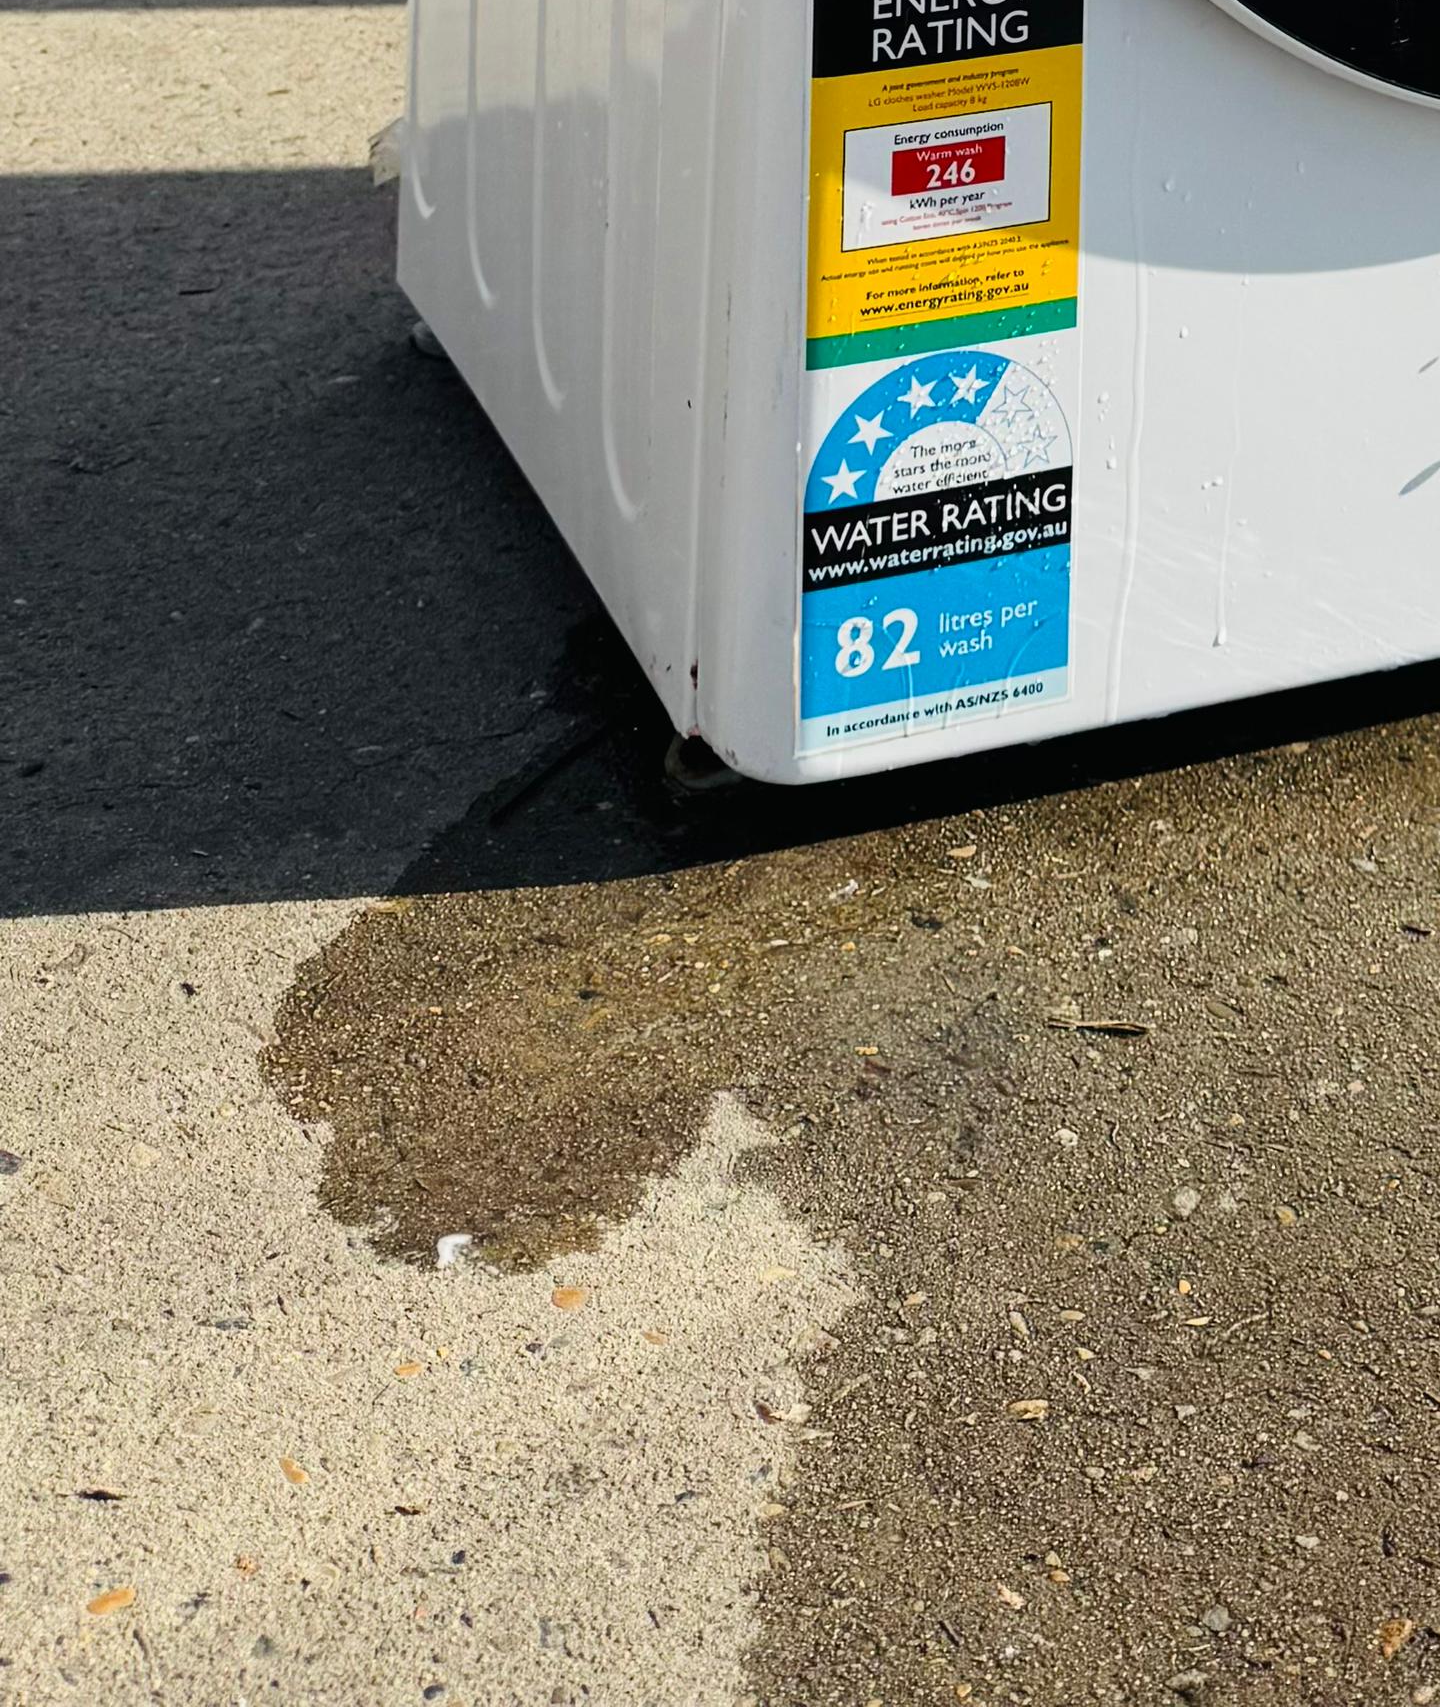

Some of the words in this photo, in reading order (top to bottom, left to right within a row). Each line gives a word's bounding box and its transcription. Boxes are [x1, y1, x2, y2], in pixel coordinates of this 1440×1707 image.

[872, 11, 1028, 62] RATING
[868, 98, 881, 107] LG
[913, 102, 933, 112] Load
[894, 133, 931, 146] Energy
[935, 122, 1004, 140] consumption
[916, 149, 951, 162] Warm
[955, 144, 982, 156] wash
[926, 159, 976, 189] 246
[910, 197, 936, 209] kWh
[940, 196, 957, 207] per
[962, 192, 985, 205] year
[866, 291, 884, 300] For
[888, 287, 916, 297] more
[919, 276, 983, 292] information,
[986, 271, 1010, 282] refer
[1013, 269, 1024, 277] to
[860, 283, 1029, 316] www.energyrating.gov.au
[910, 445, 936, 459] The
[940, 439, 977, 454] more
[894, 465, 926, 478] stars
[931, 459, 952, 472] the
[955, 452, 992, 469] more
[893, 480, 932, 495] water
[936, 469, 989, 486] efficient
[811, 508, 931, 555] WATER
[941, 484, 1066, 532] RATING
[809, 520, 1067, 581] www.waterrating.gov.au
[835, 607, 920, 678] 82
[939, 609, 992, 633] litres
[1001, 600, 1038, 628] per
[939, 629, 992, 658] wash
[827, 725, 839, 737] In
[844, 709, 920, 734] accordance
[924, 703, 952, 718] with
[955, 690, 1008, 711] AS/NZS
[1013, 682, 1044, 698] 6400
